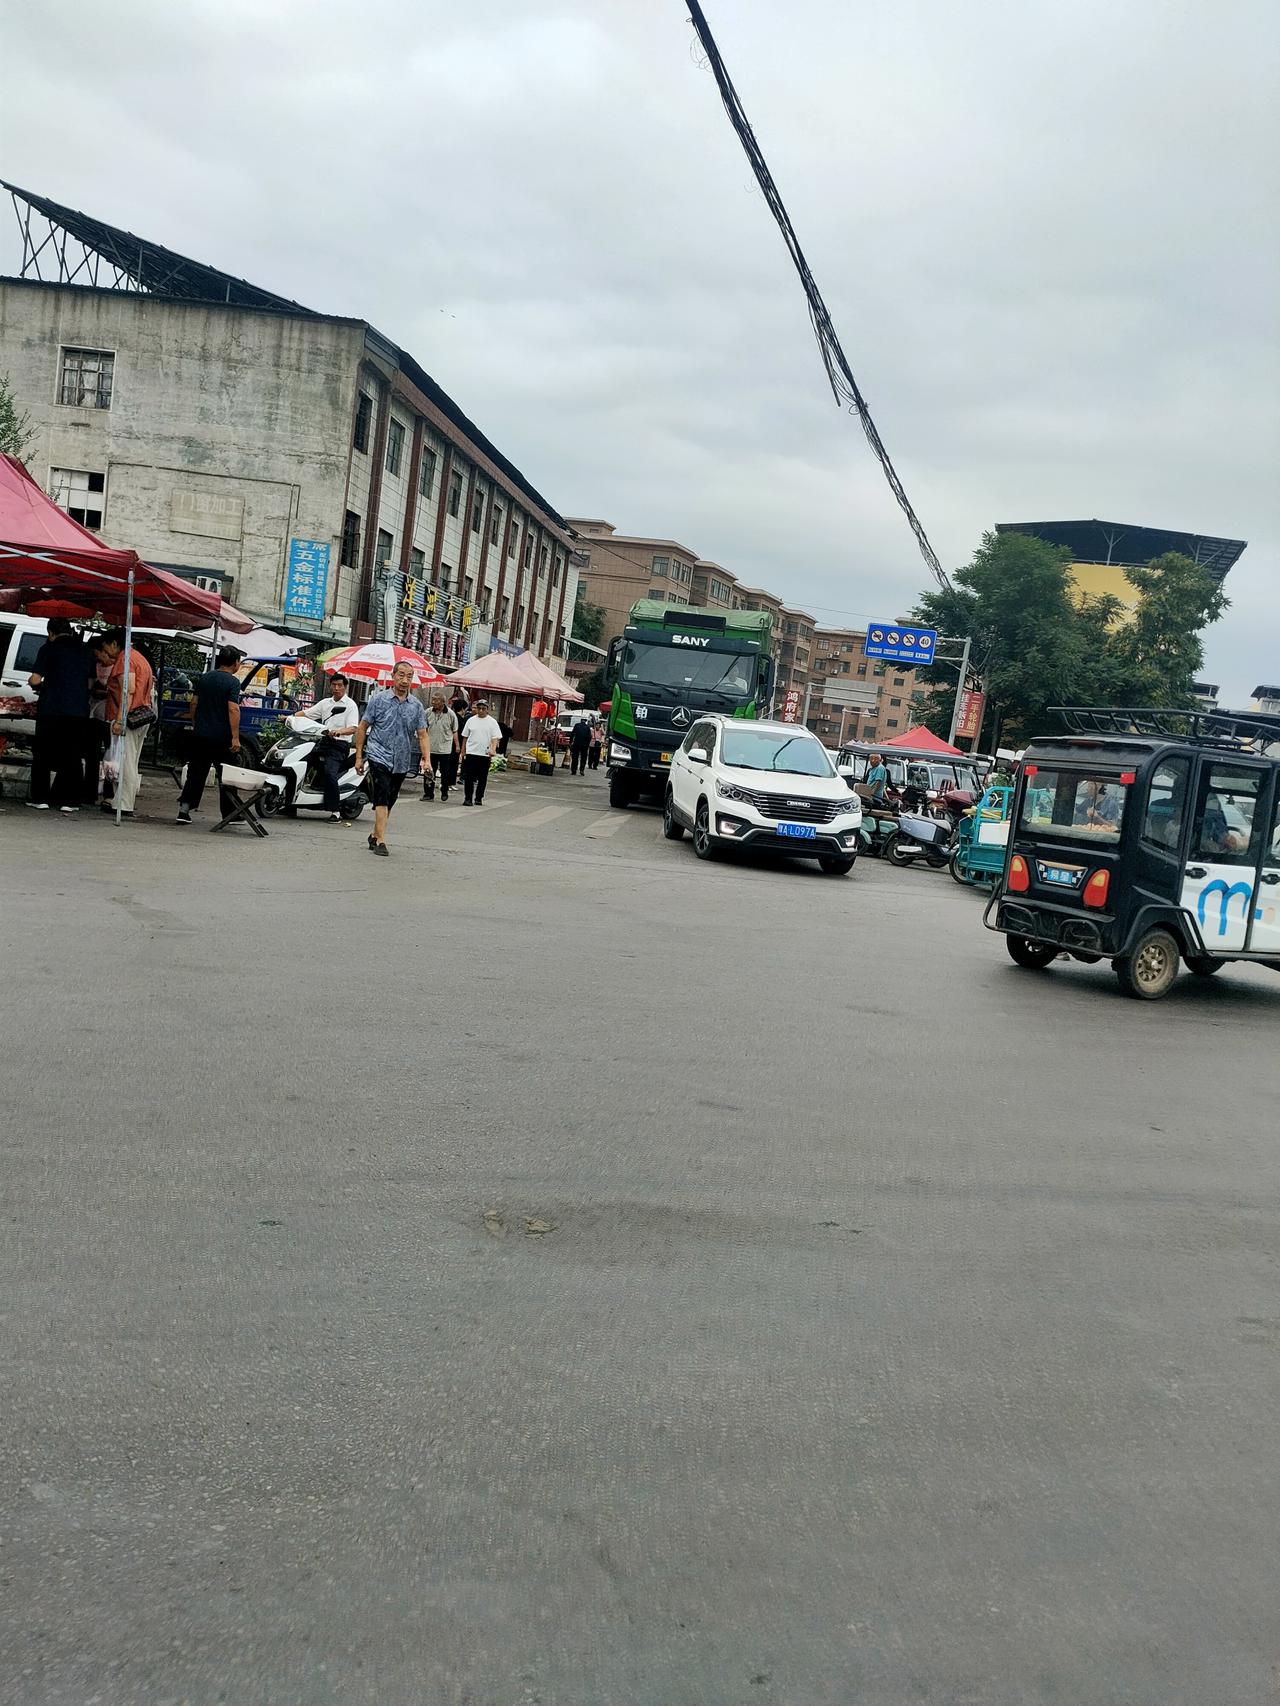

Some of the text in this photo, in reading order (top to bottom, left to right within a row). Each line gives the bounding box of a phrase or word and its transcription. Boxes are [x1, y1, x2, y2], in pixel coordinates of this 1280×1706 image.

[290, 550, 317, 608] 五金标准件
[672, 634, 710, 647] SANY
[920, 638, 930, 646] 40
[966, 695, 981, 730] 二手轮胎
